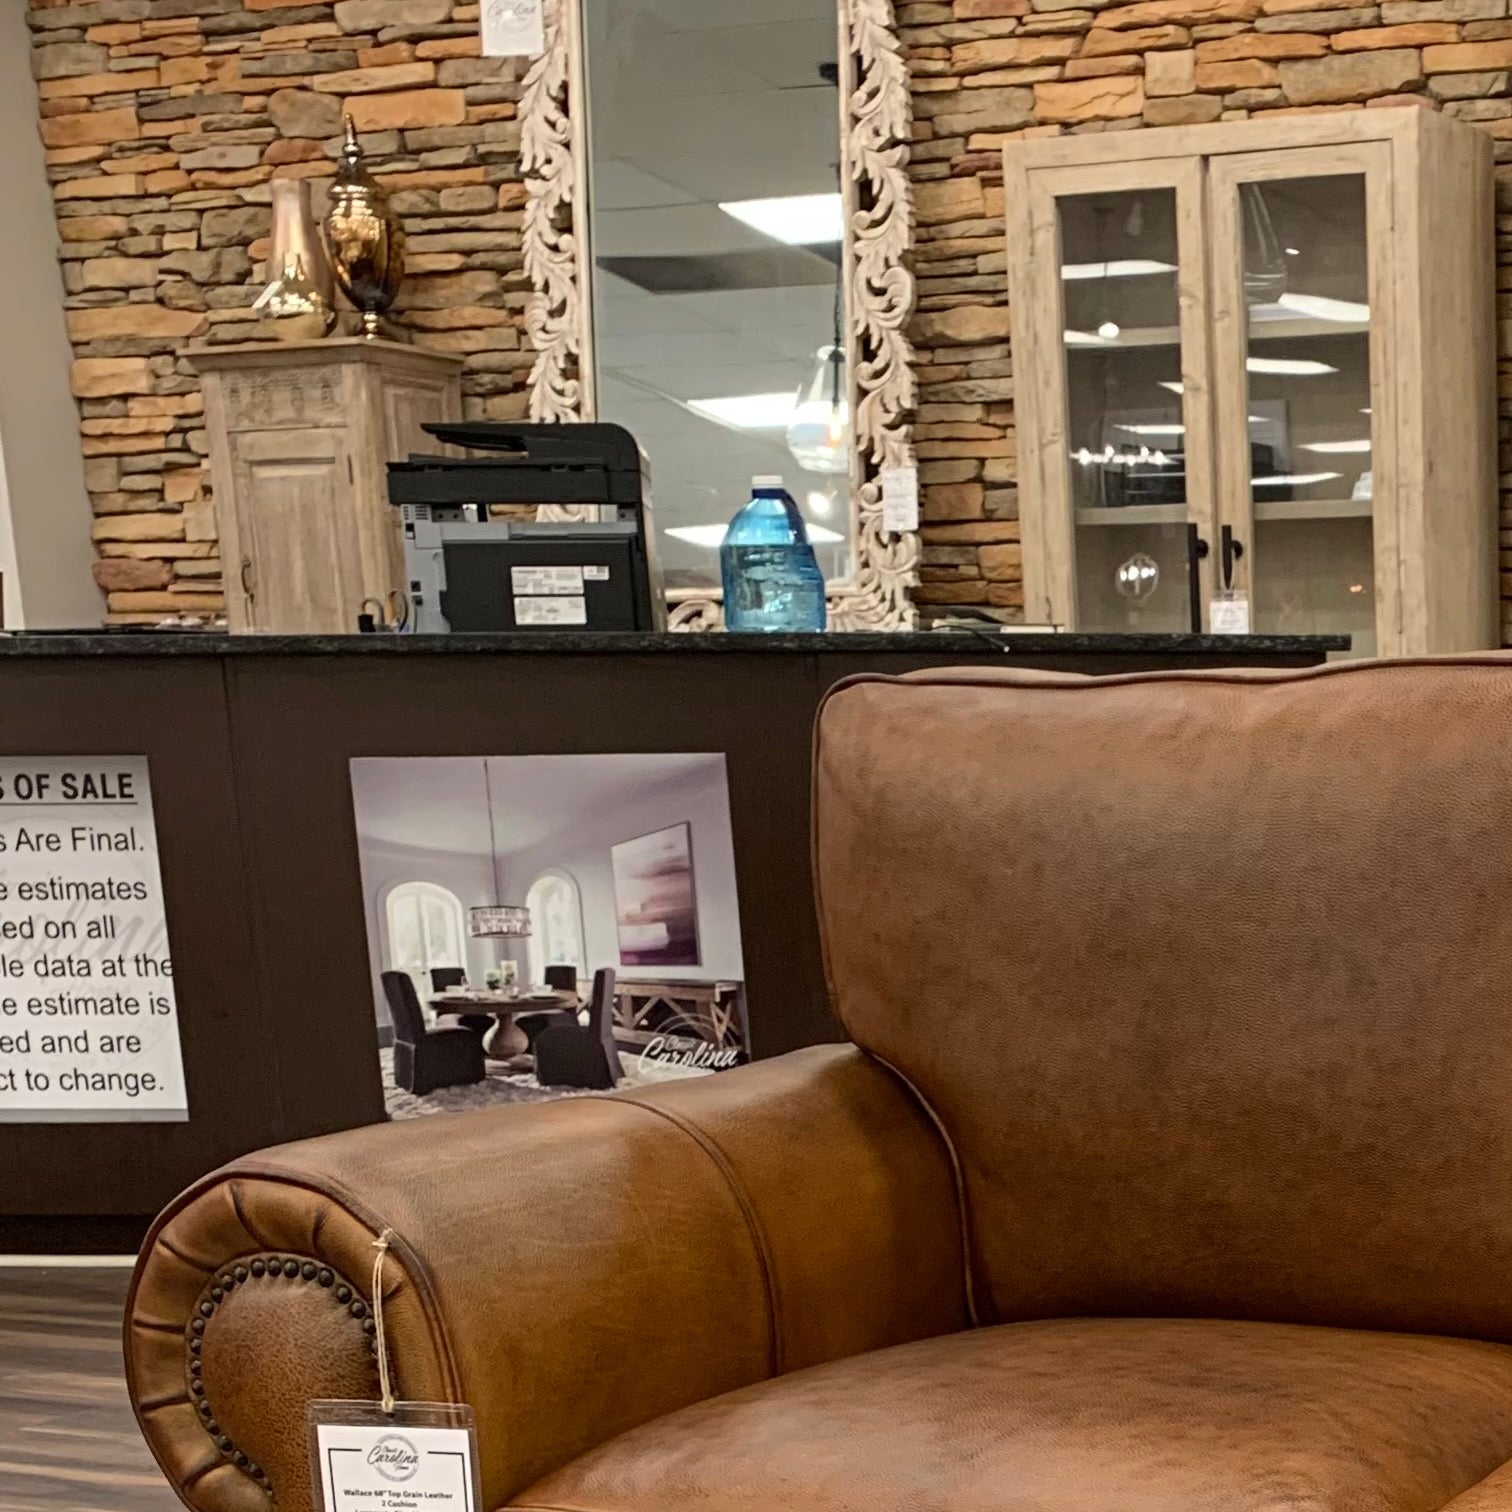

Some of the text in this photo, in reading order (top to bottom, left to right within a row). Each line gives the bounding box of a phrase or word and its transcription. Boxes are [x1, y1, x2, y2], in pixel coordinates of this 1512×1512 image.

[13, 773, 50, 800] OF
[61, 773, 135, 800] SALE
[14, 827, 61, 852] Are
[71, 826, 144, 852] Final.
[18, 876, 148, 901] estimates
[44, 919, 77, 939] on
[86, 915, 116, 939] all
[34, 953, 91, 978] data
[101, 954, 127, 978] at
[134, 953, 173, 978] the
[27, 992, 140, 1016] estimate
[148, 991, 171, 1016] is
[41, 1030, 90, 1053] and
[99, 1034, 142, 1053] are
[637, 1036, 739, 1074] Carolina
[25, 1068, 50, 1091] to
[59, 1068, 164, 1097] change.
[366, 1445, 420, 1465] Carolina
[343, 1489, 372, 1497] Wallace
[387, 1490, 401, 1499] Top
[402, 1491, 423, 1499] Grain
[424, 1491, 453, 1500] Leather
[387, 1500, 418, 1508] Cushion
